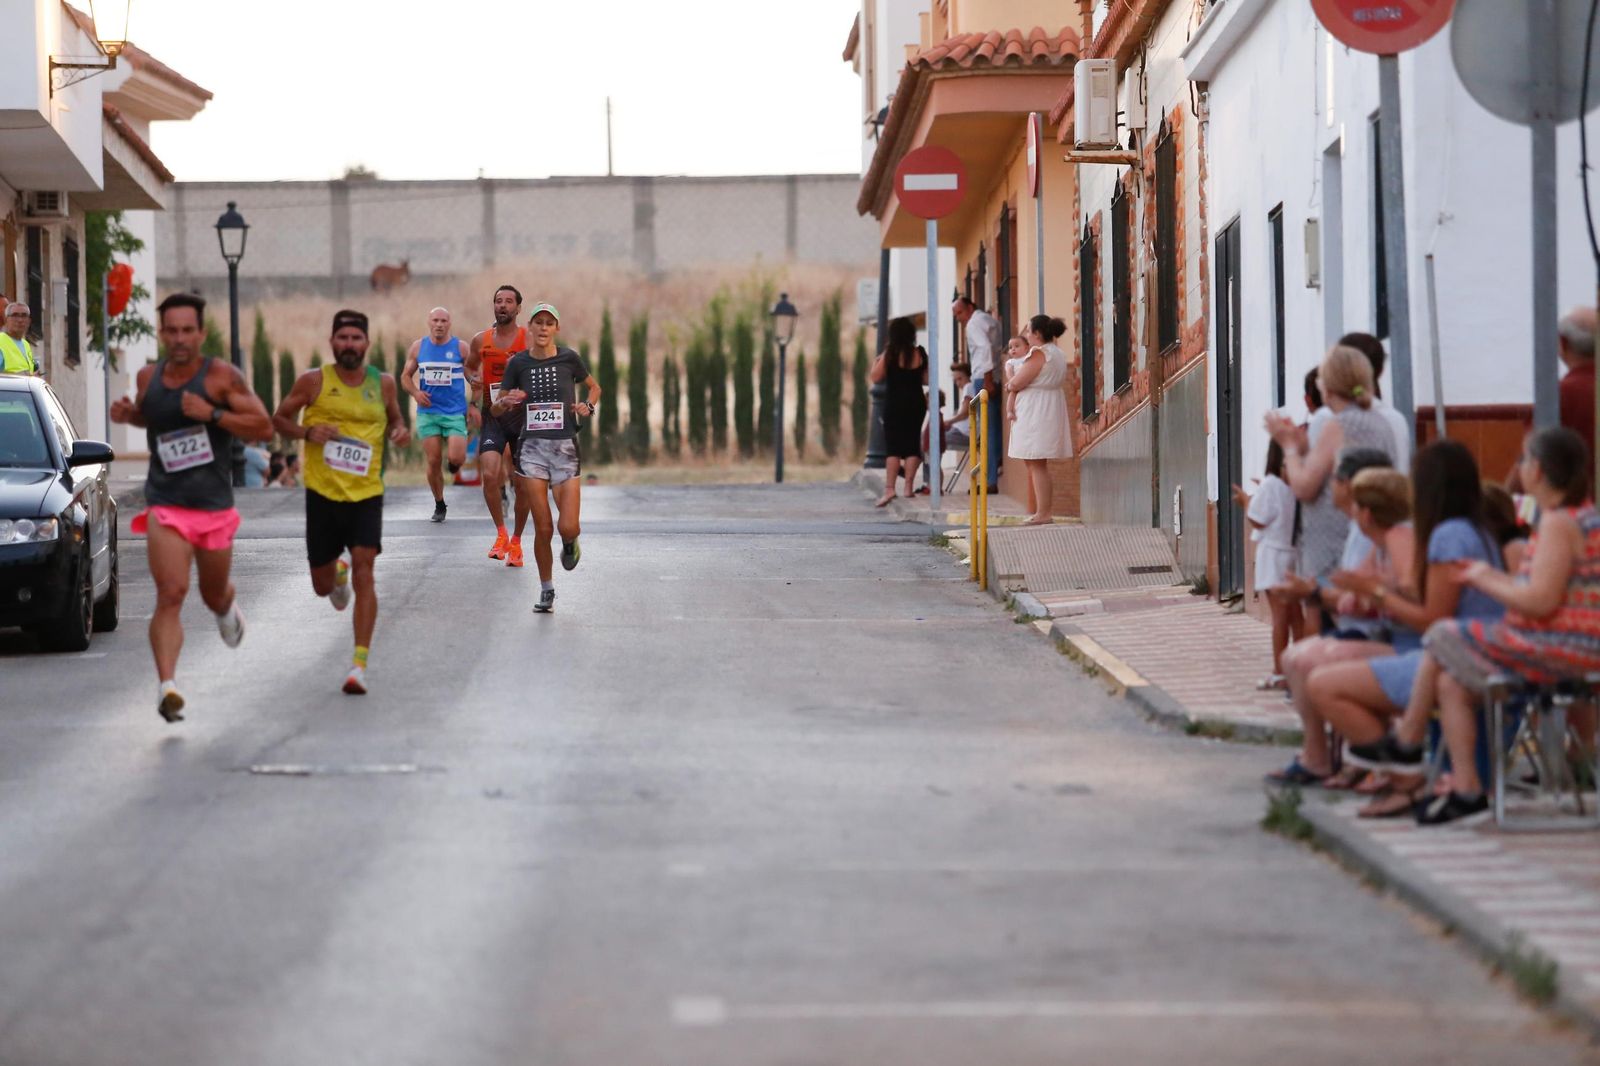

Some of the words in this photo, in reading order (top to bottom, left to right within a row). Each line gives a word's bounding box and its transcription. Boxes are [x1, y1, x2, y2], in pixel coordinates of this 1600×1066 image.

[433, 371, 443, 379] 77
[530, 366, 557, 374] NIKE
[534, 411, 556, 422] 424
[170, 438, 199, 457] 122
[336, 445, 361, 462] 180
